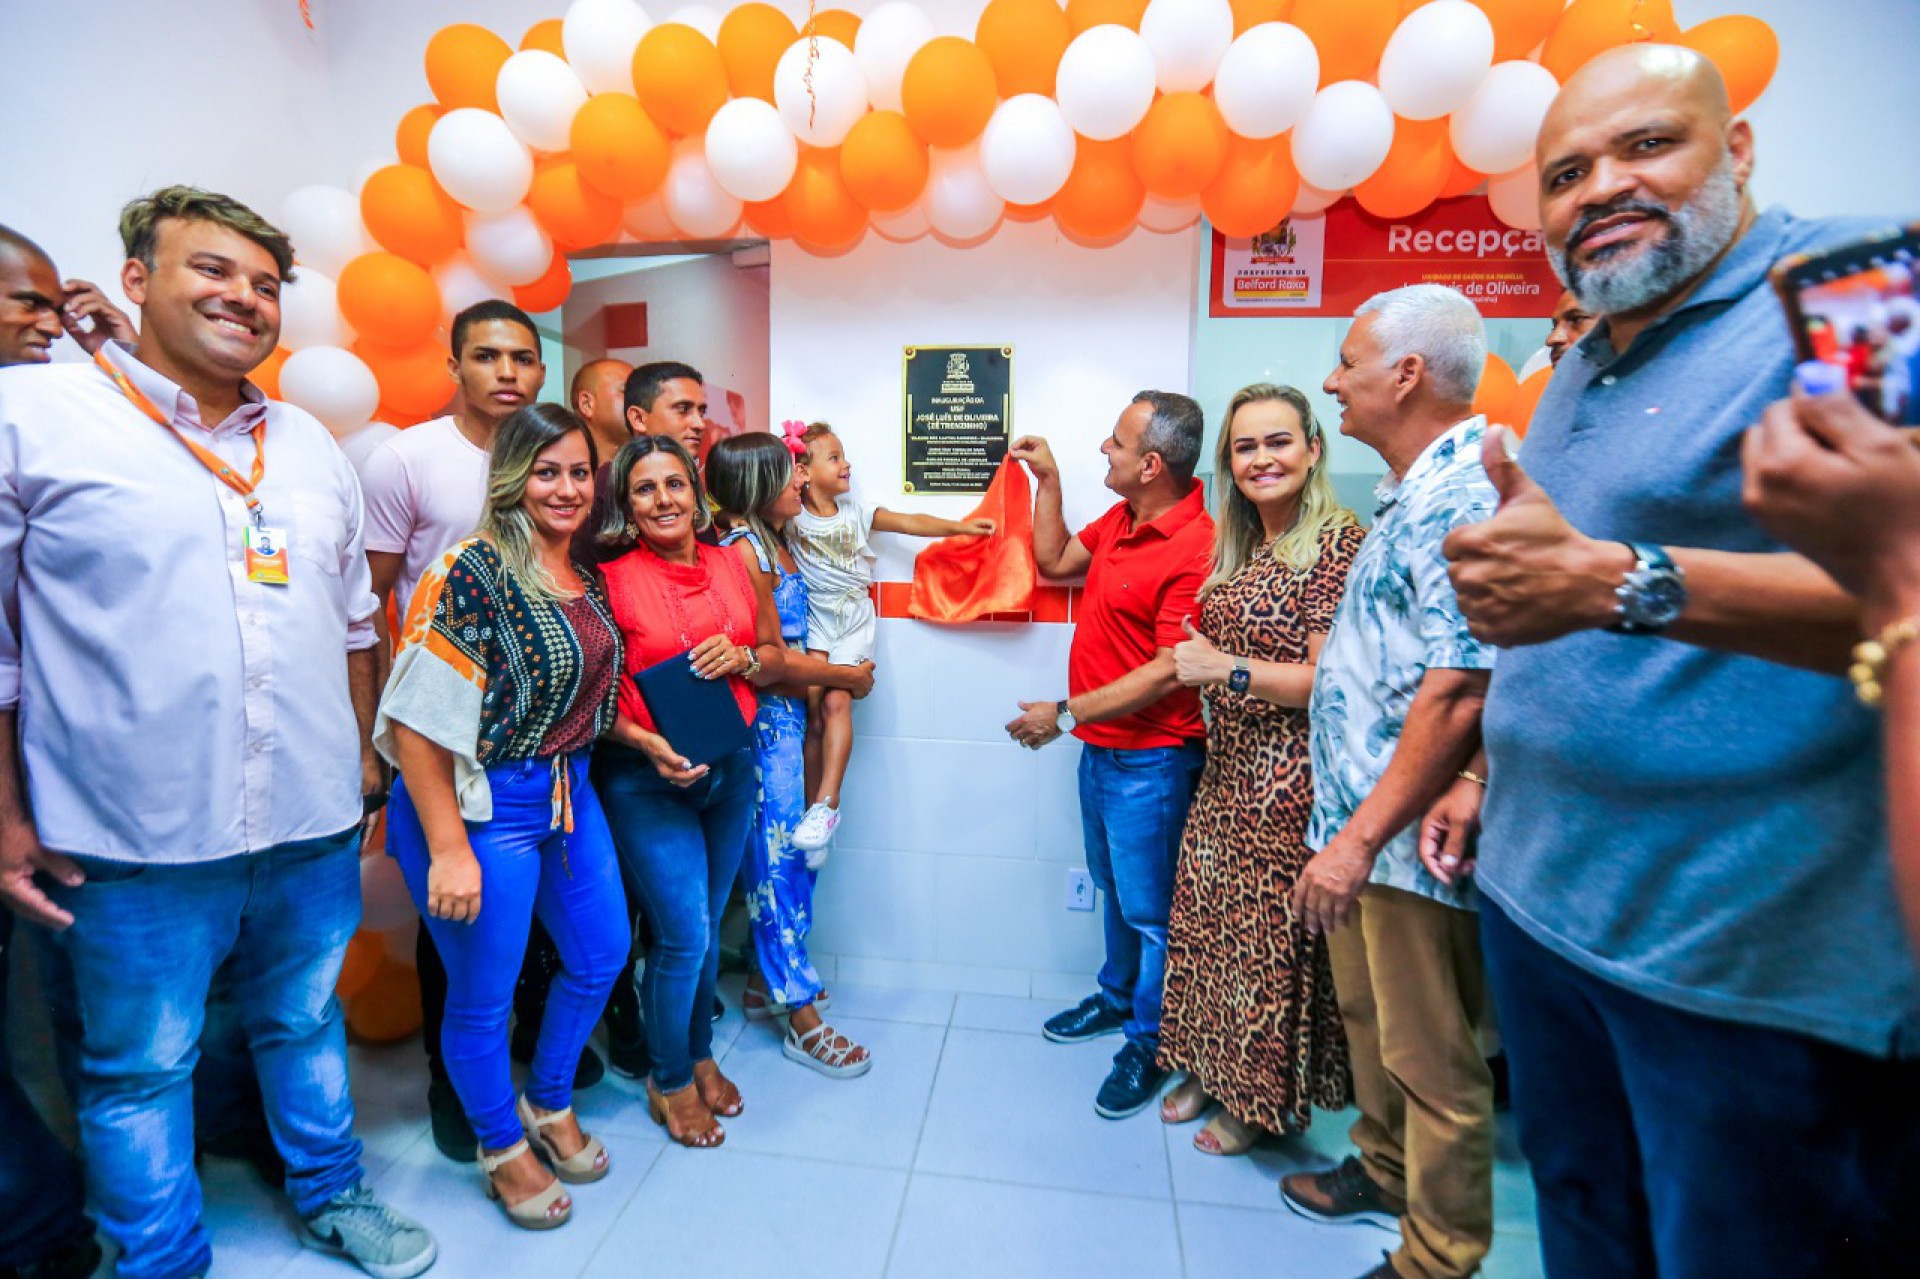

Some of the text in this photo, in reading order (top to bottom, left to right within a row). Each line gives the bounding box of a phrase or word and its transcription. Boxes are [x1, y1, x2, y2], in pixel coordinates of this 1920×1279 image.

[1237, 279, 1306, 289] Belford Roxo
[1466, 281, 1483, 295] de
[1486, 281, 1540, 295] Oliveira
